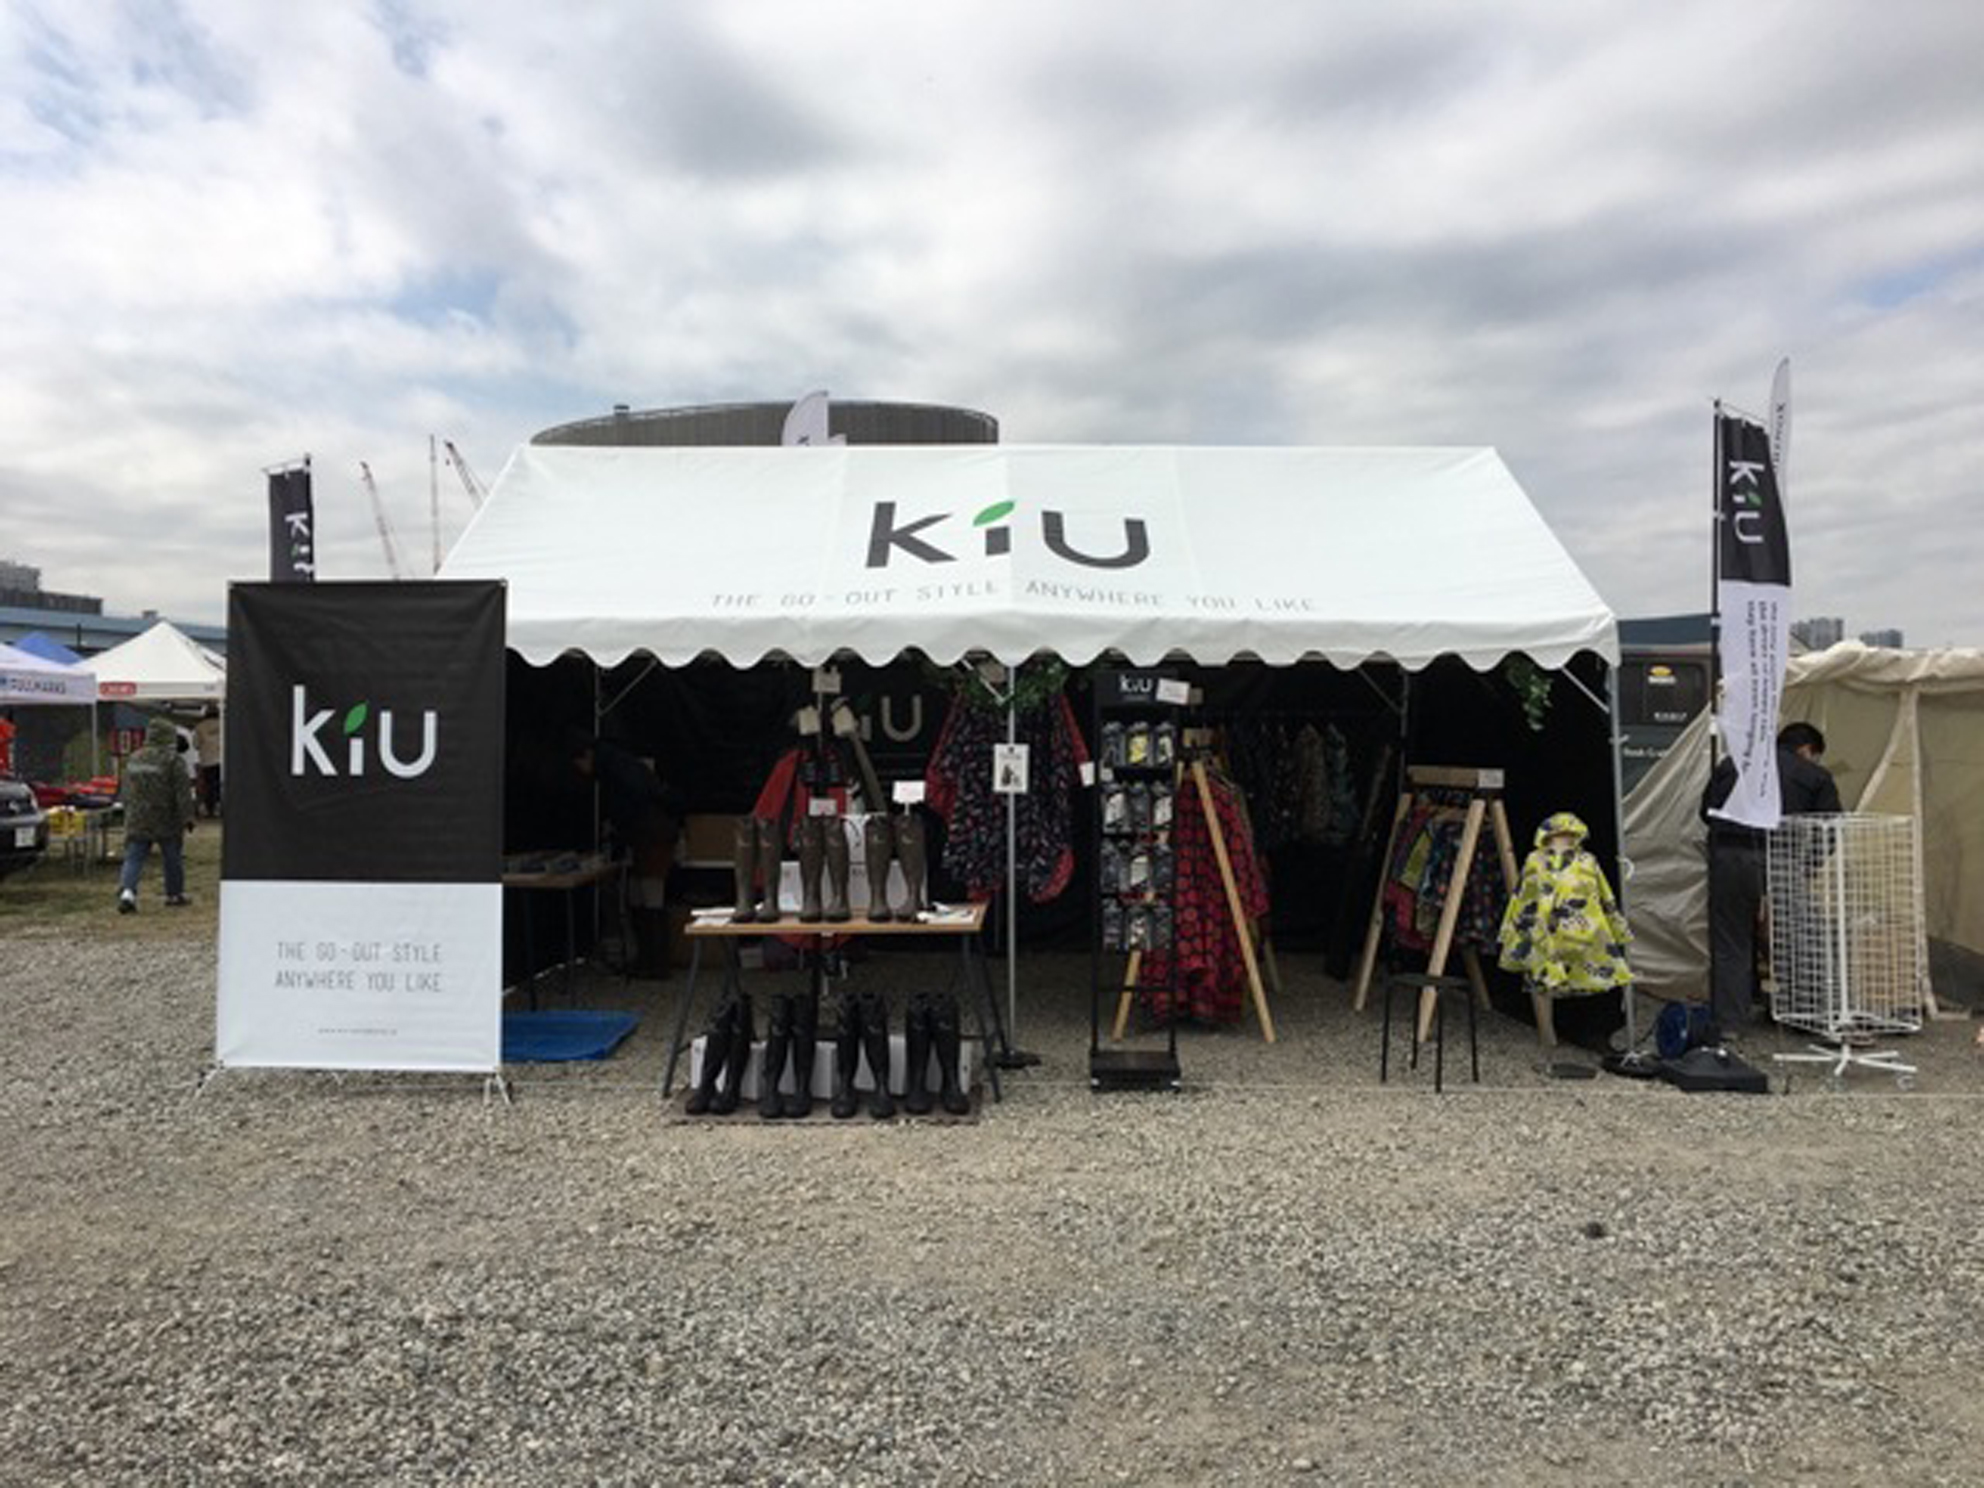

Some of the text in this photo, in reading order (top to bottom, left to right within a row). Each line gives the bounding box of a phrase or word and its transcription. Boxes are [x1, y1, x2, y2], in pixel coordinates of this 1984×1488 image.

[712, 593, 760, 608] THE
[916, 579, 999, 601] STYLE
[1025, 579, 1162, 607] ANYWHERE
[1187, 594, 1236, 611] YOU
[1253, 597, 1315, 612] LIKE
[277, 941, 306, 962] THE
[392, 942, 442, 963] STYLE
[275, 970, 442, 993] ANYWHERE YOU LIKE
